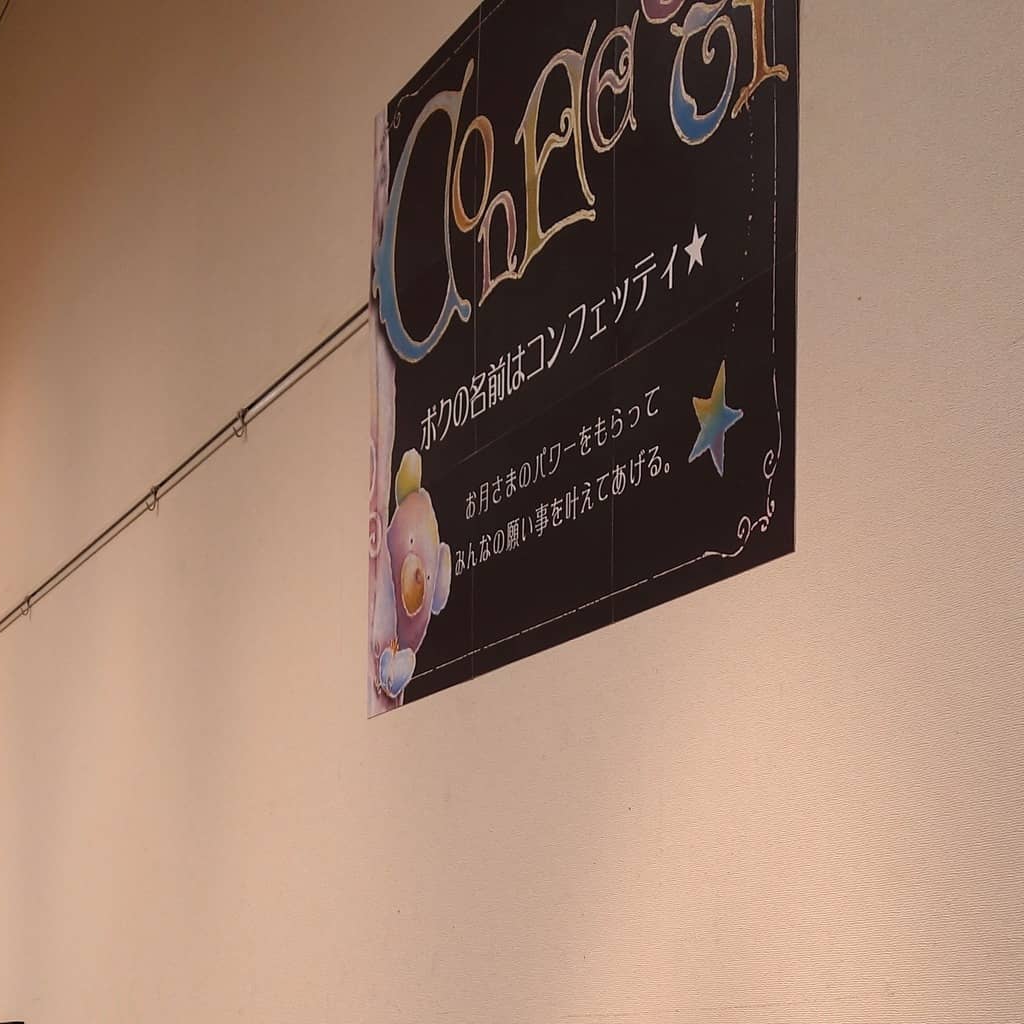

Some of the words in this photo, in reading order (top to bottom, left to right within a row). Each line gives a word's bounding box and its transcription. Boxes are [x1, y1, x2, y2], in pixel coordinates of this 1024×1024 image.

[465, 385, 661, 520] お月さまのパワーをもらって
